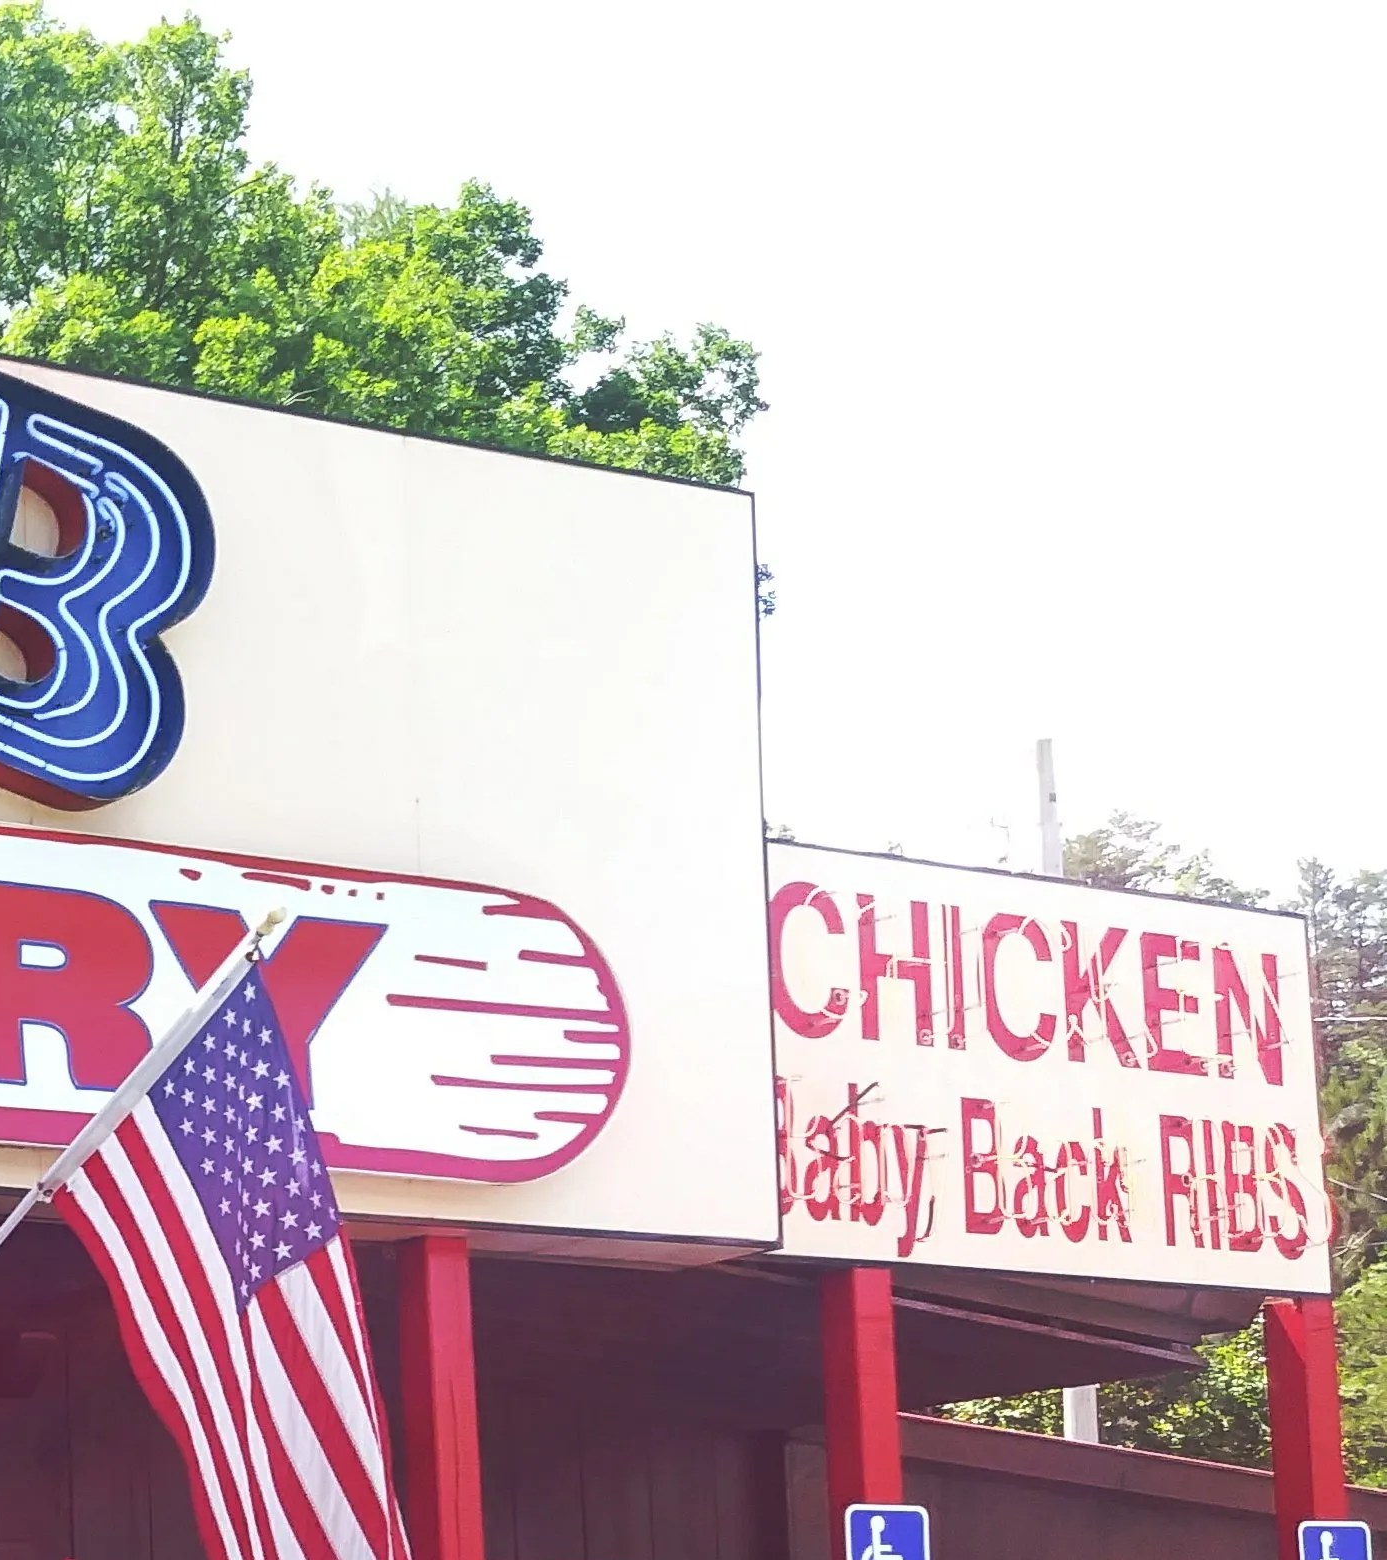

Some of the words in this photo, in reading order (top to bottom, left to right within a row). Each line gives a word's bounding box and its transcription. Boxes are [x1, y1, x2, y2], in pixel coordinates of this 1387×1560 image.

[768, 881, 1285, 1086] CHICKEN
[960, 1096, 1134, 1244] Back
[1159, 1113, 1309, 1261] RIBS
